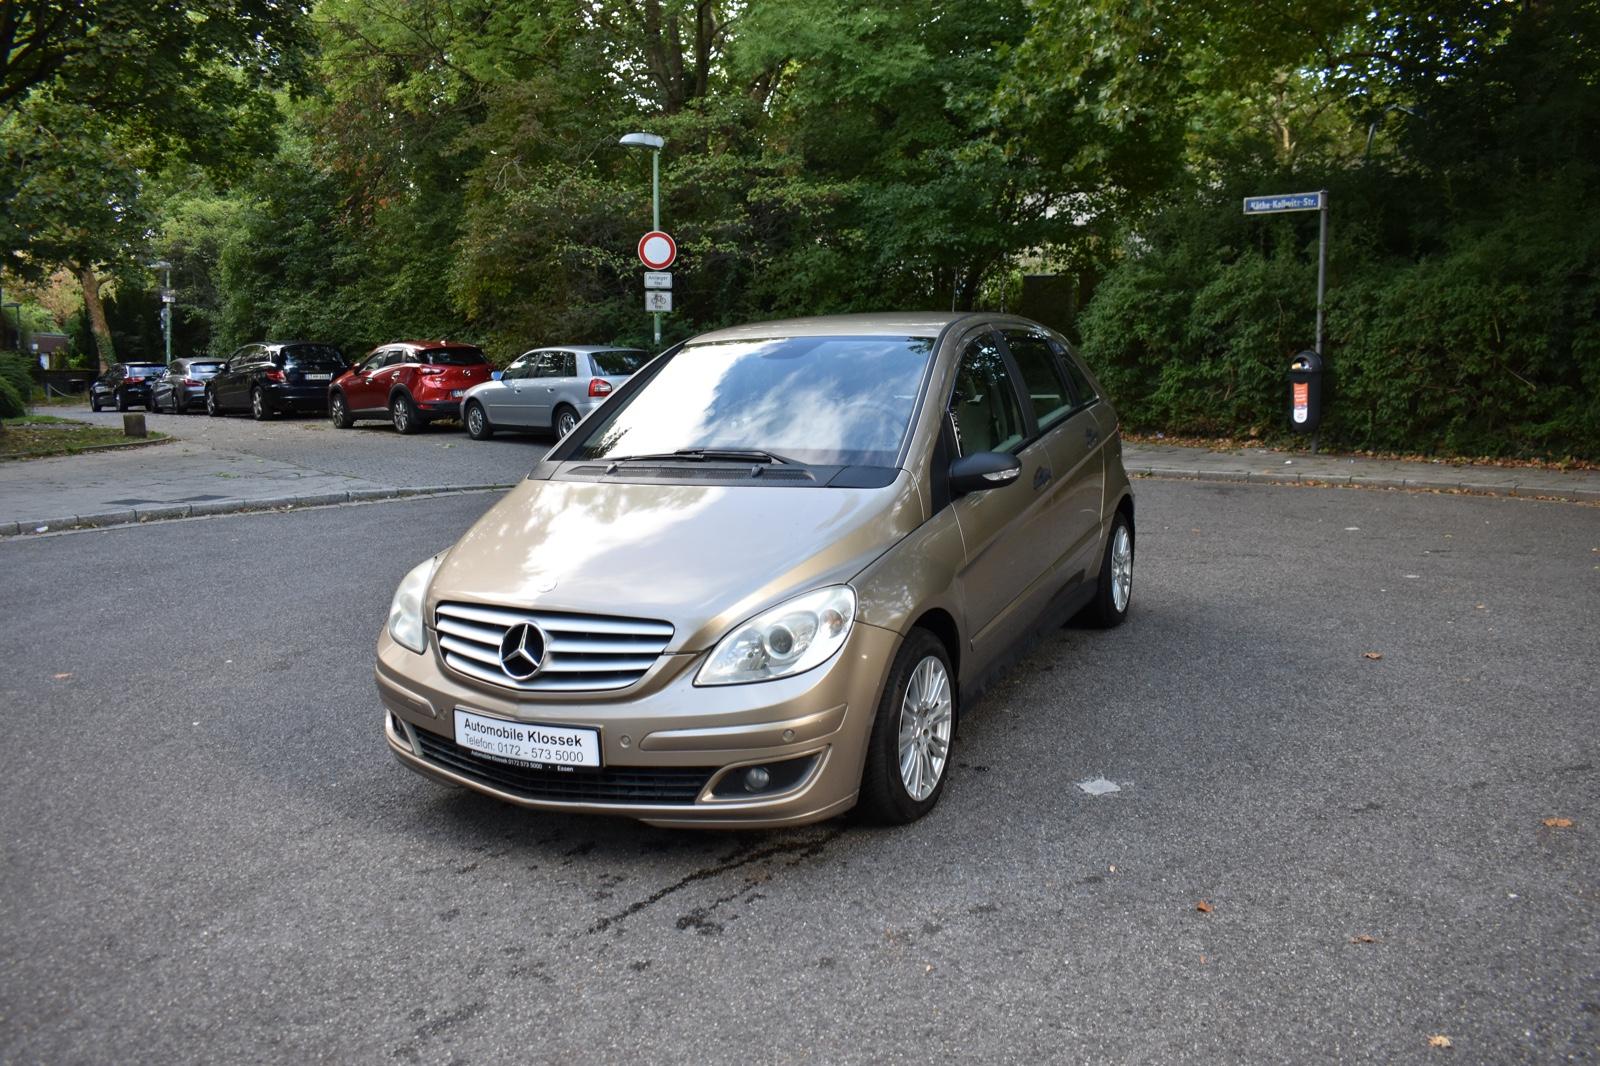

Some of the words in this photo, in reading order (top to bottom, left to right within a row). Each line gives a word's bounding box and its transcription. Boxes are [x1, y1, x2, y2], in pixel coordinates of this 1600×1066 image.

[464, 718, 523, 741] Automobile
[528, 730, 583, 747] Klossek
[465, 734, 495, 750] Telefon:
[497, 742, 521, 757] 0172
[531, 748, 551, 760] 573
[555, 751, 584, 763] 5000
